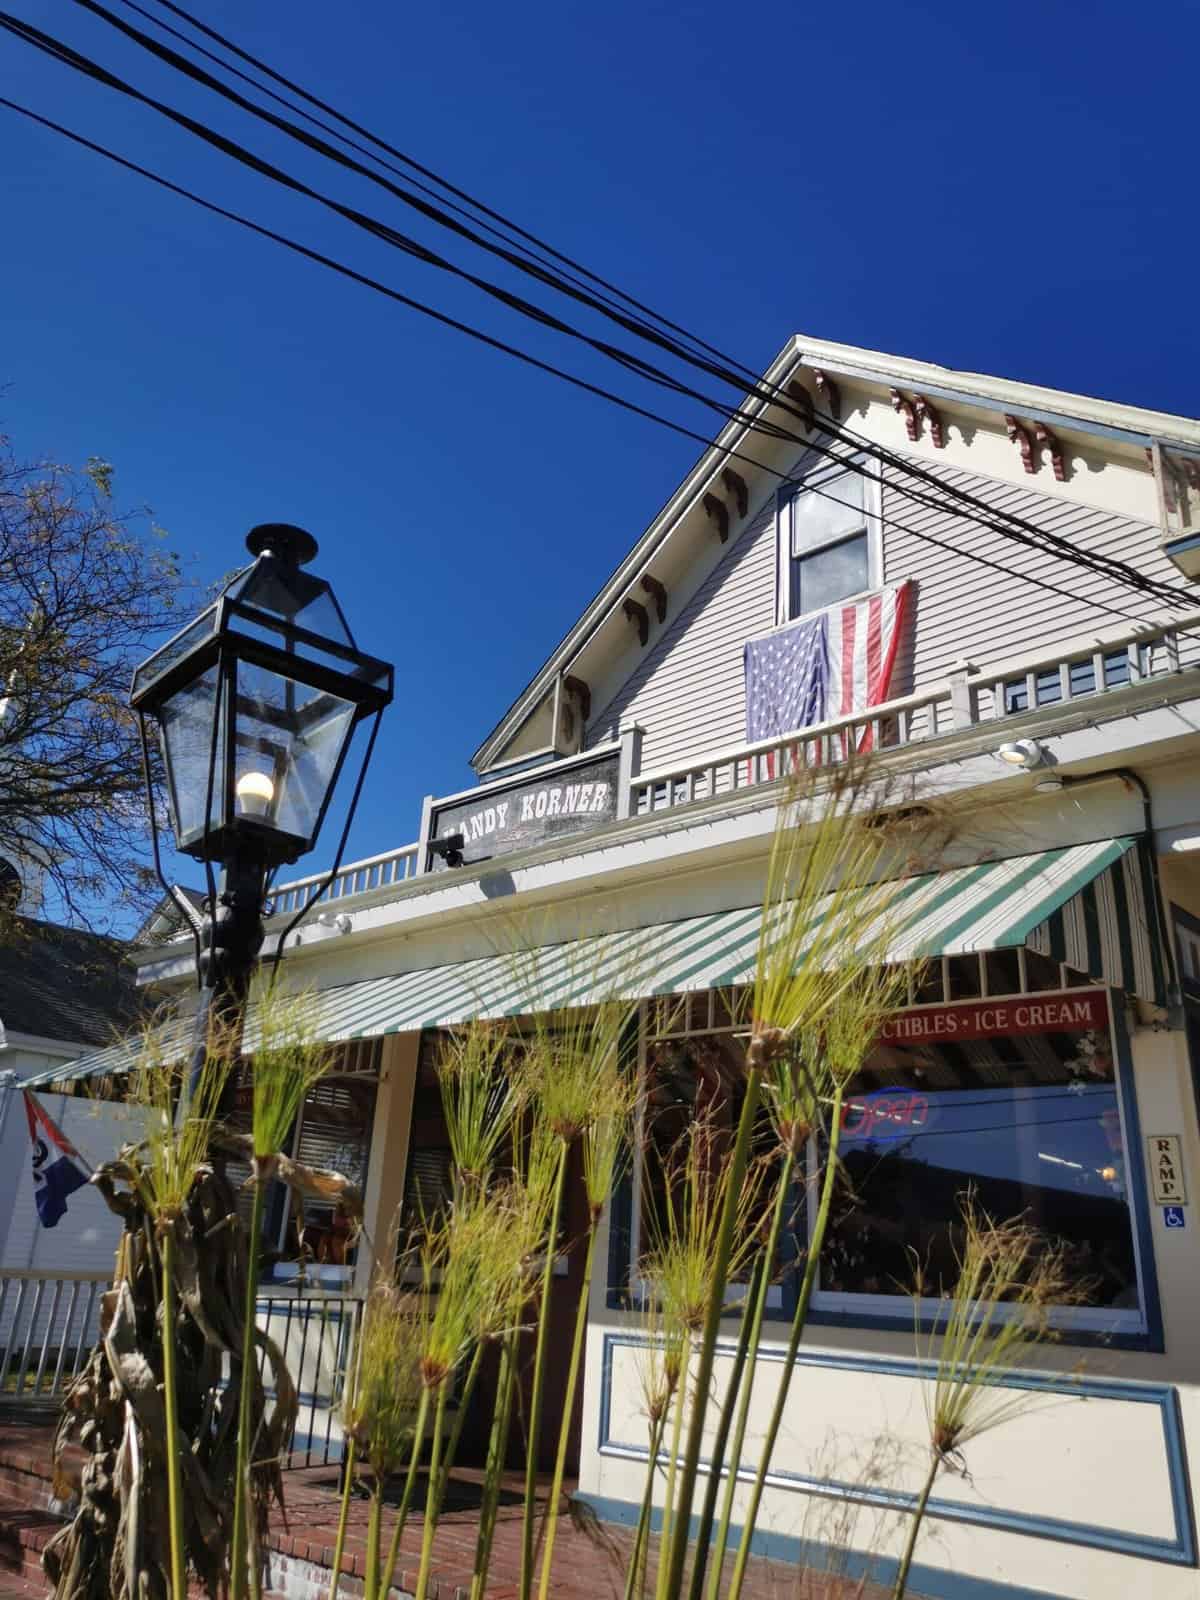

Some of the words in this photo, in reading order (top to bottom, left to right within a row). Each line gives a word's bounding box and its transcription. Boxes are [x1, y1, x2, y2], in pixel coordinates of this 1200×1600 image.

[521, 783, 610, 821] KORNER
[975, 1009, 1009, 1032] ICE
[1015, 1002, 1093, 1027] CREAM
[1156, 1139, 1177, 1194] RAMP
